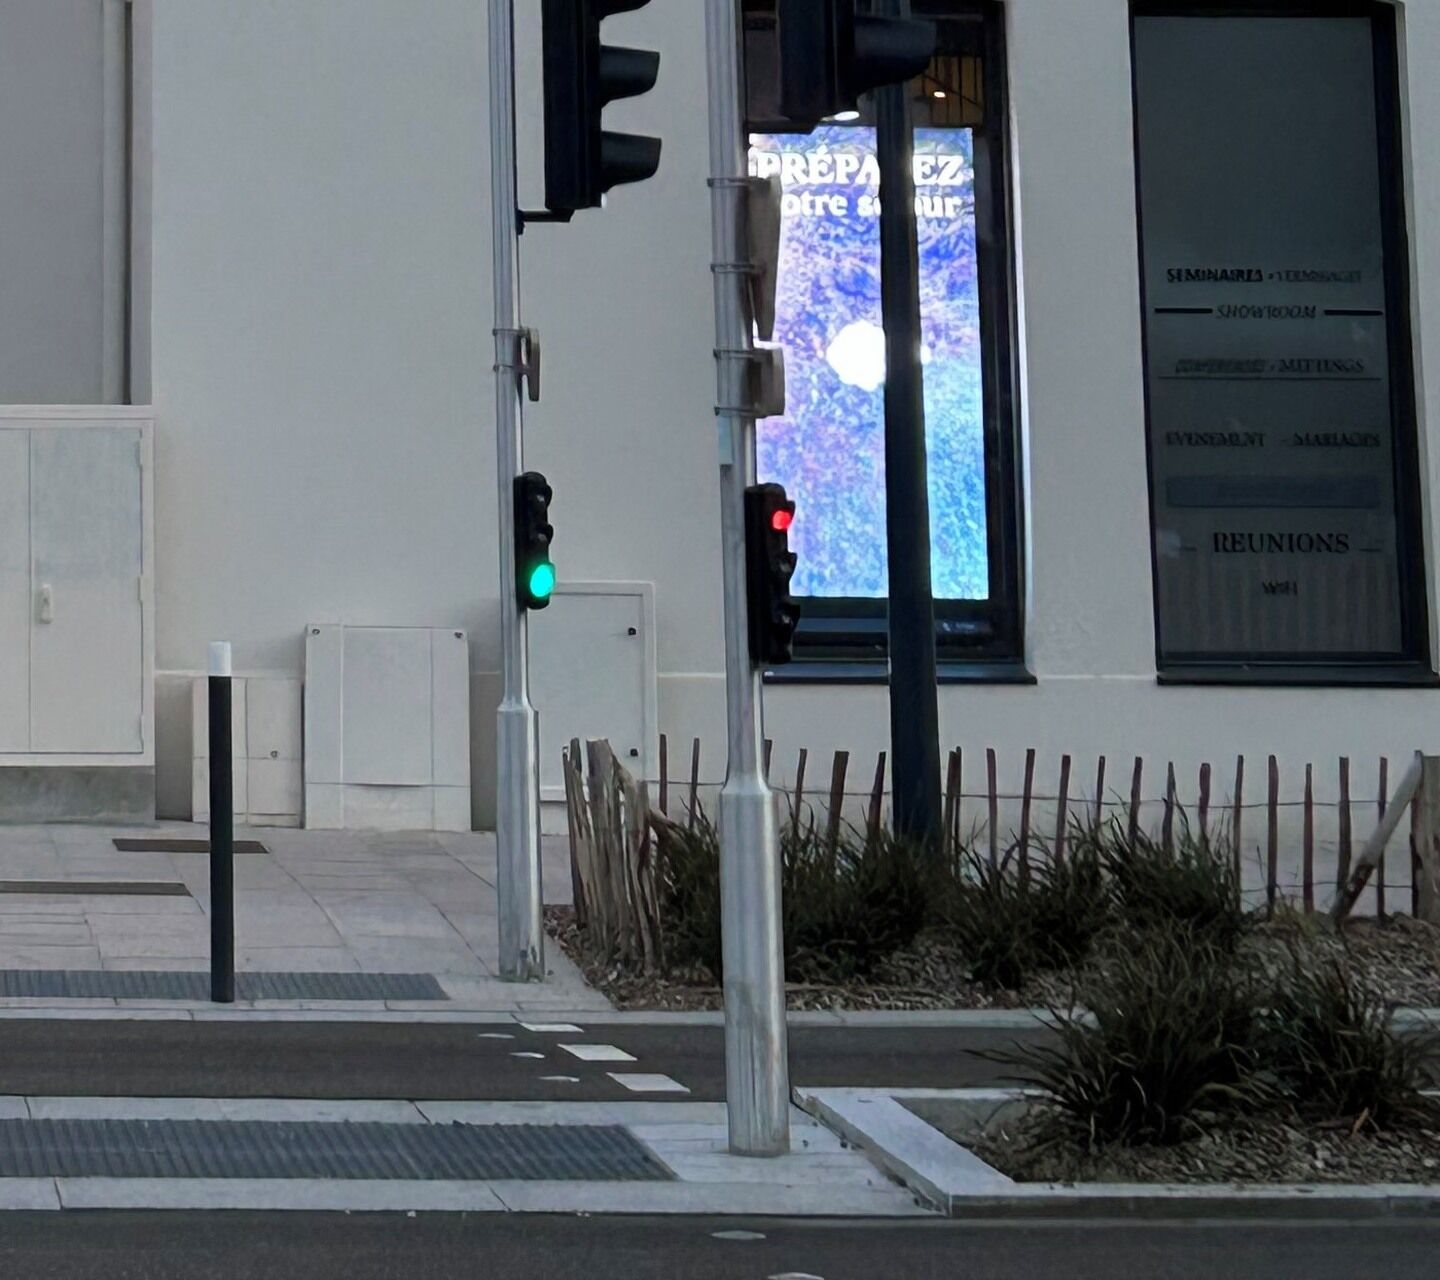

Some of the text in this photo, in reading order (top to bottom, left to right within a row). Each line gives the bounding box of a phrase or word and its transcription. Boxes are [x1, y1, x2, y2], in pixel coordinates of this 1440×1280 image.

[756, 144, 964, 186] PRÉPAEZ
[781, 190, 848, 217] otre
[1212, 531, 1351, 555] REUNIONS
